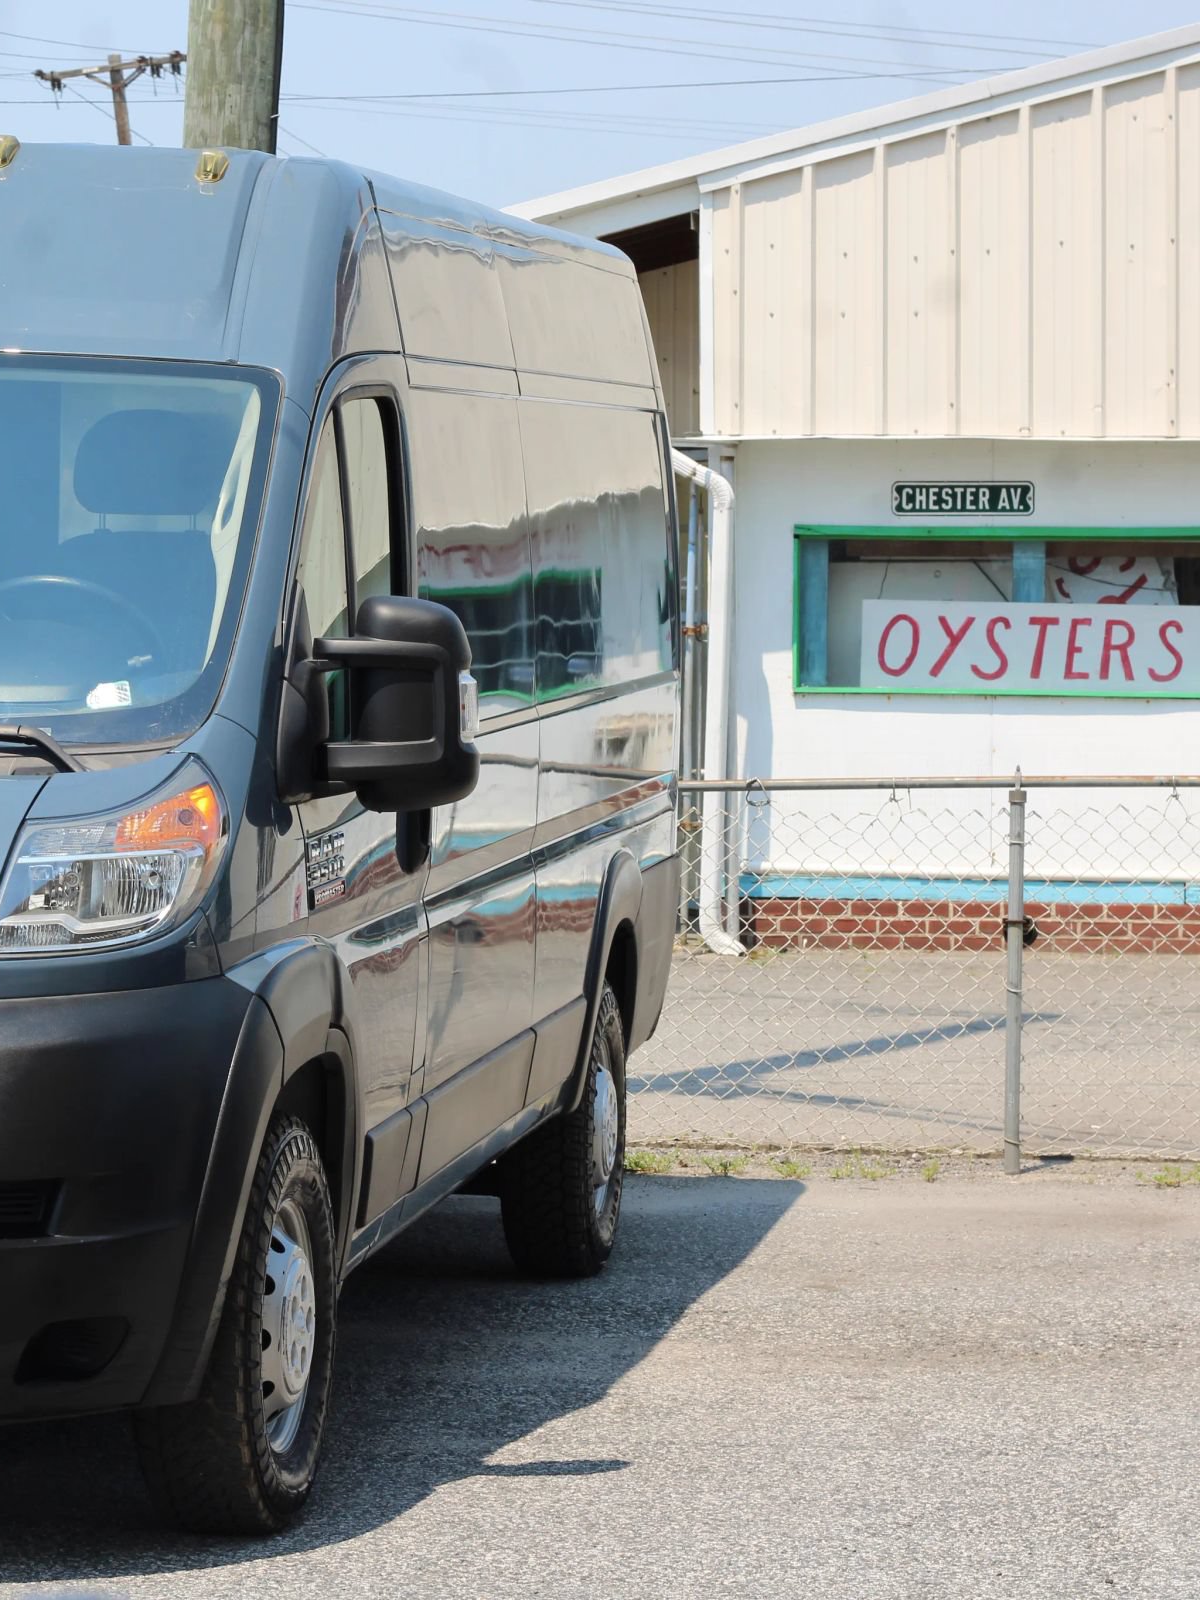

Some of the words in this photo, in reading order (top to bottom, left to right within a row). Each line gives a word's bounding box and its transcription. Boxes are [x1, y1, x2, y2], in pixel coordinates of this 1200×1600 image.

[901, 487, 990, 511] CHESTER
[998, 487, 1025, 510] AV.
[877, 613, 1184, 682] OYSTERS
